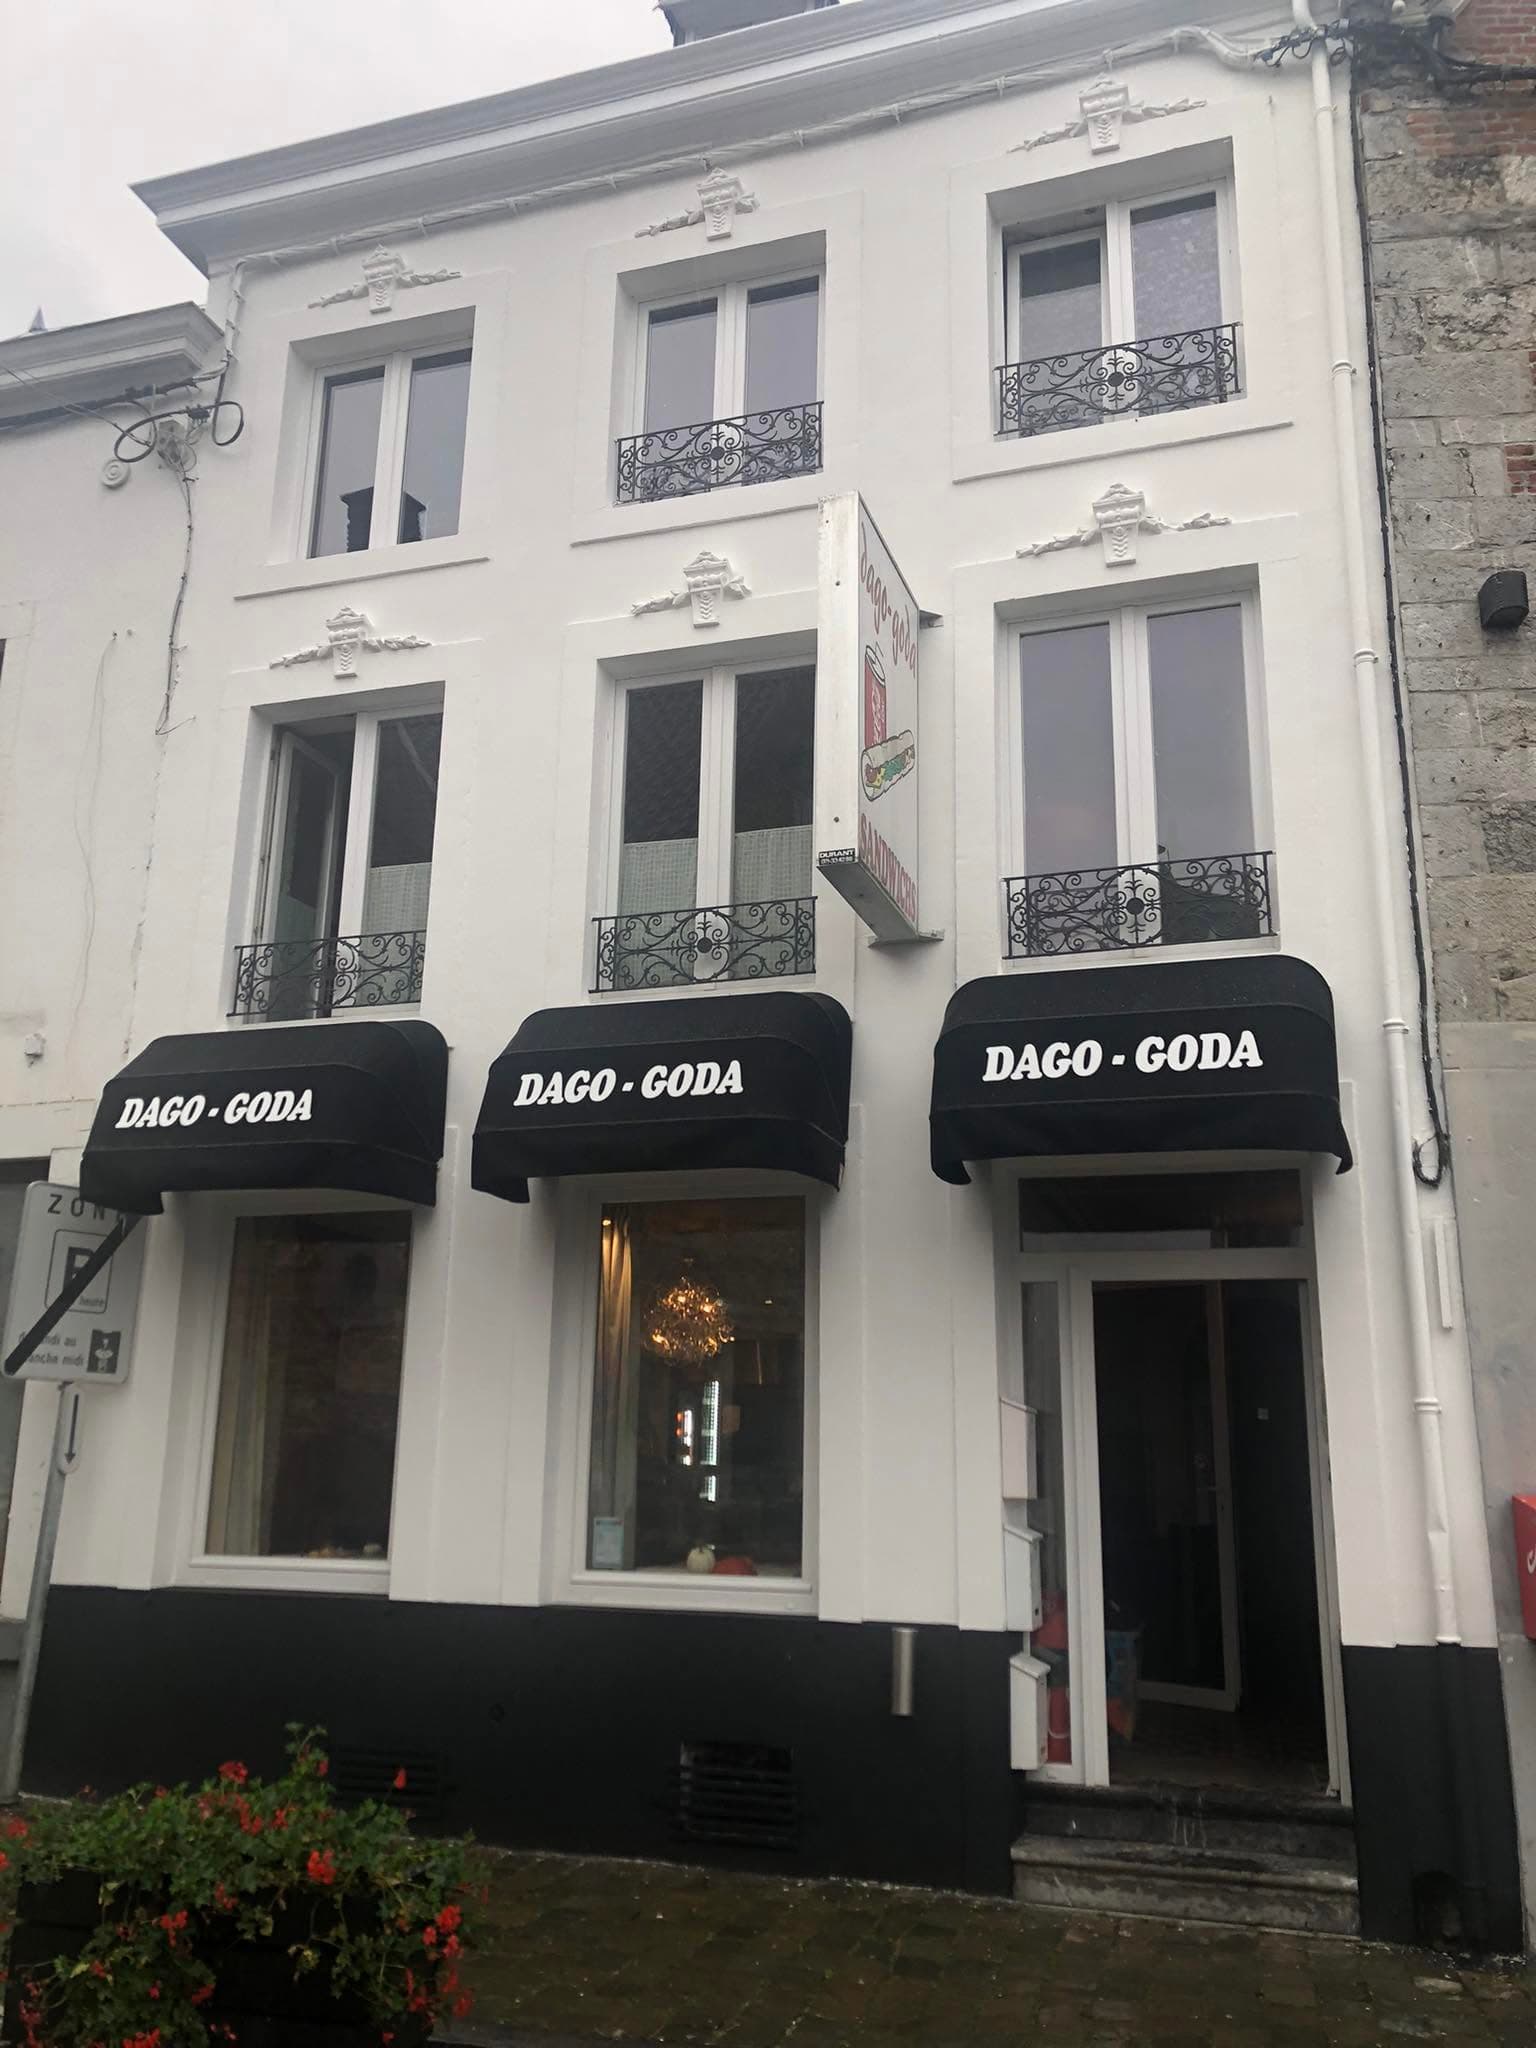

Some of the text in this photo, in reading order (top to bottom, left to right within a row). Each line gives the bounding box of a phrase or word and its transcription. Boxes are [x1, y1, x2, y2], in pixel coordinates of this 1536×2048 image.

[981, 1039, 1103, 1082] DAGO
[1135, 1030, 1264, 1073] GODA
[513, 1068, 617, 1107] DAGO
[641, 1059, 744, 1099] GODA
[114, 1095, 206, 1129] DAGO
[223, 1088, 313, 1125] GODA
[48, 1193, 122, 1222] ZON
